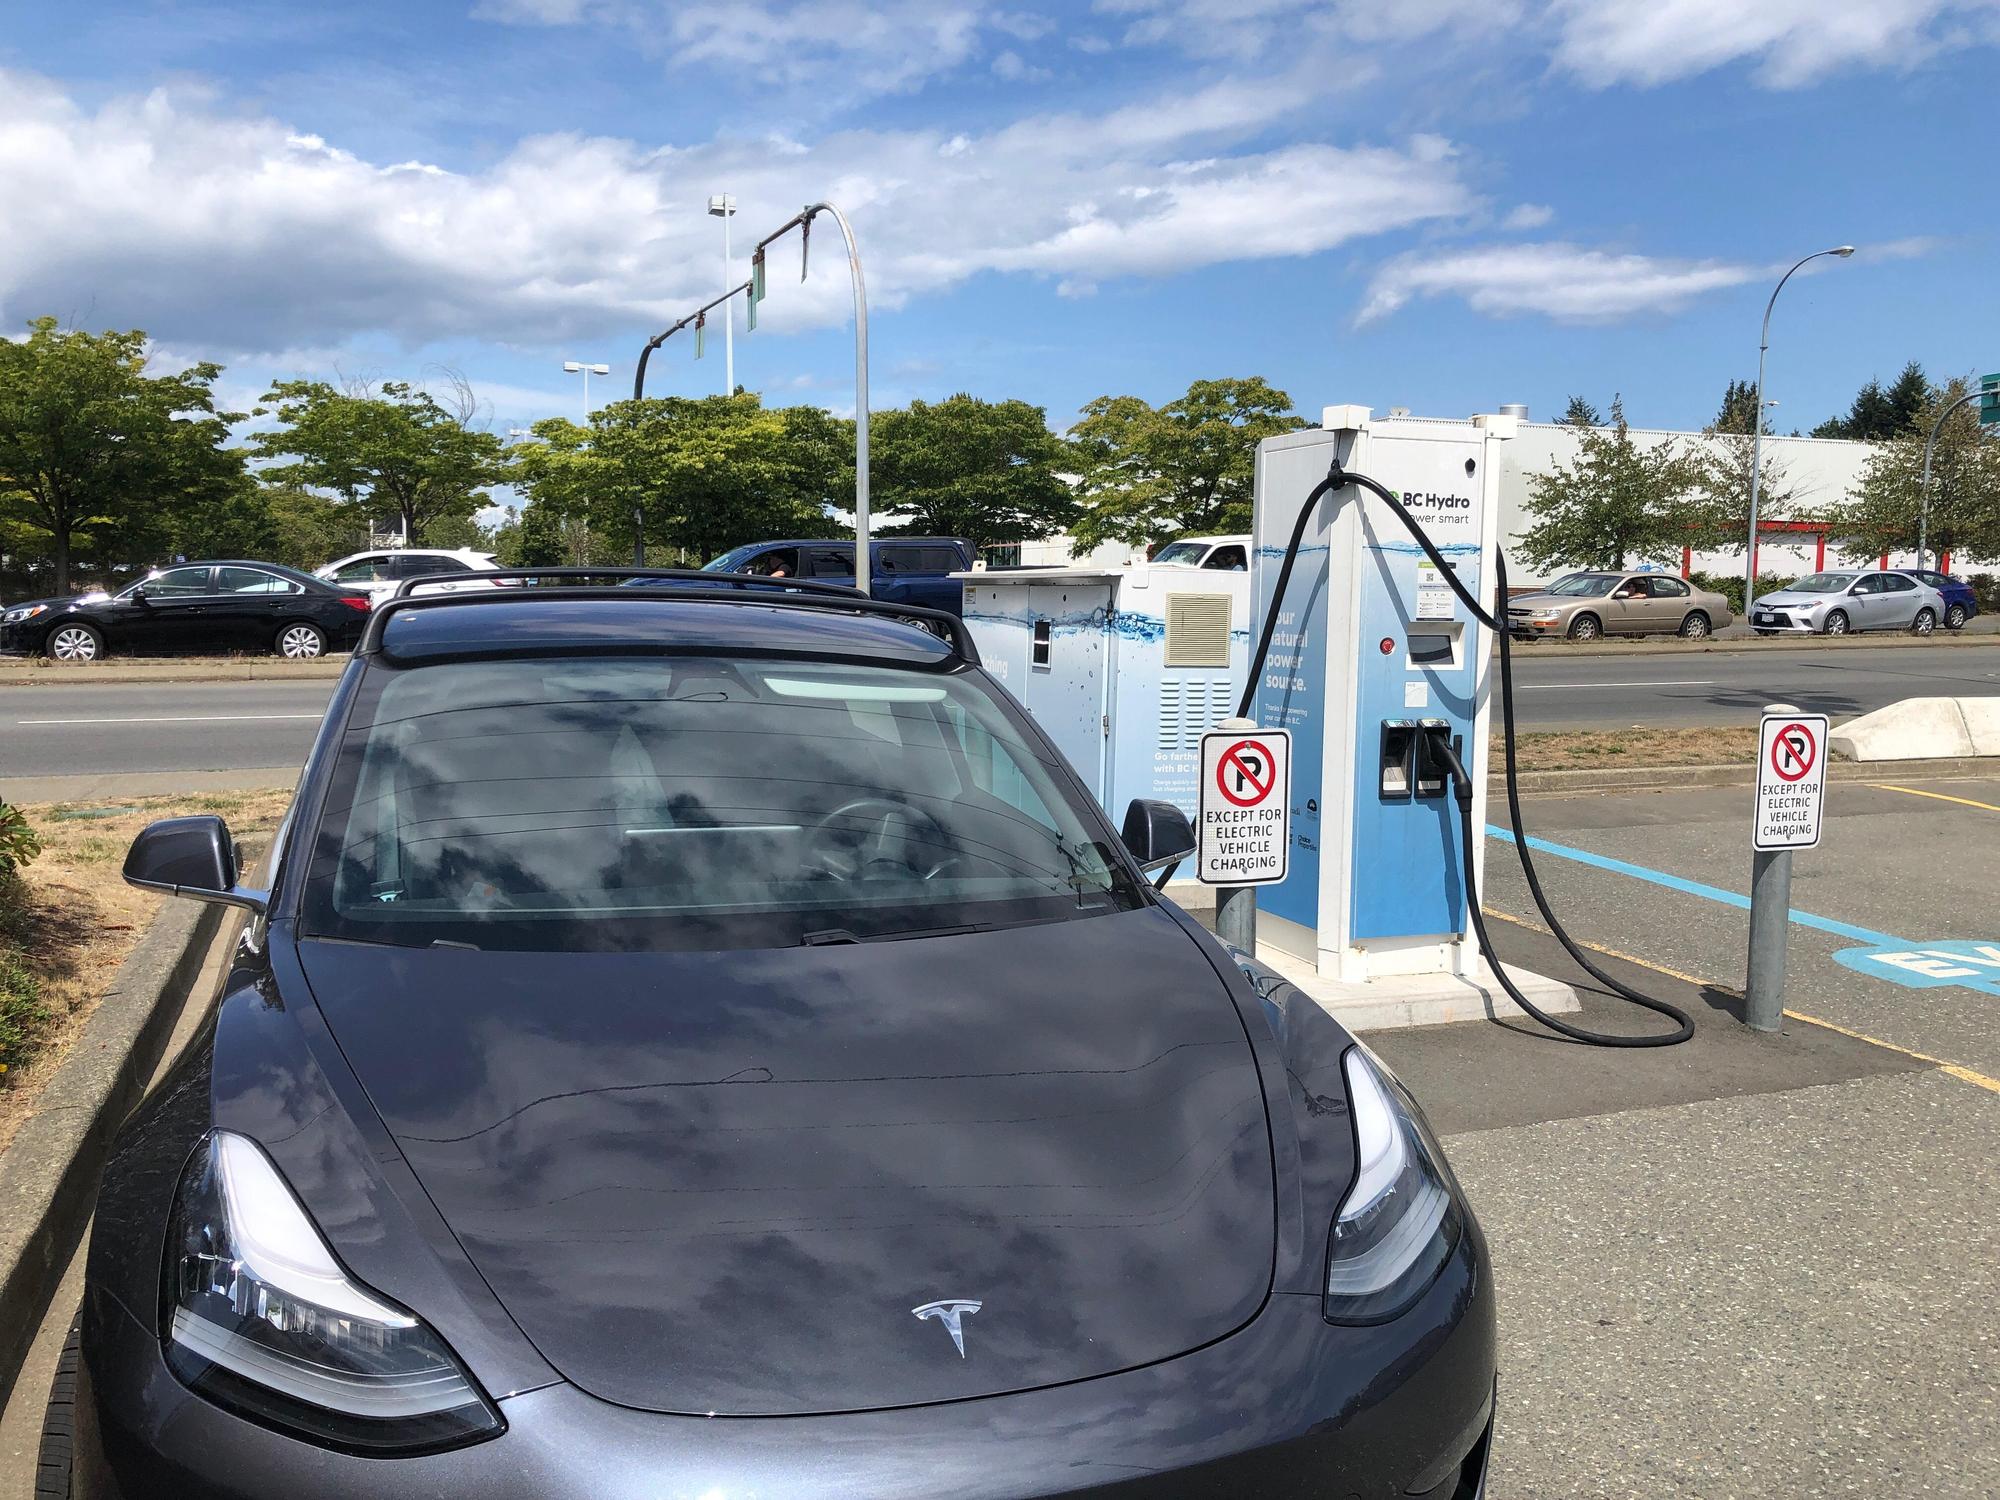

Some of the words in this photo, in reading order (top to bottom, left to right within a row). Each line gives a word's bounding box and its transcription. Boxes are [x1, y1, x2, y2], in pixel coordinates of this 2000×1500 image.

[1403, 492, 1423, 507] BC
[1425, 493, 1470, 511] Hydro
[1410, 514, 1435, 523] ower
[1438, 514, 1469, 524] smart
[1276, 611, 1295, 625] our
[1266, 653, 1303, 671] power
[1265, 674, 1307, 691] source.
[1154, 752, 1168, 761] Go
[1170, 752, 1198, 761] farthe
[1154, 764, 1175, 773] with
[1177, 764, 1191, 773] BC
[1762, 784, 1798, 795] EXCEPT
[1800, 783, 1819, 794] FOR
[1768, 797, 1811, 809] ELECTRIC
[1206, 810, 1255, 823] EXCEPT
[1259, 808, 1282, 821] FOR
[1770, 811, 1808, 822] VEHICLE
[1216, 824, 1273, 839] ELECTRIC
[1763, 824, 1812, 836] CHARGING
[1220, 840, 1270, 854] VEHICLE
[1210, 856, 1277, 871] CHARGING
